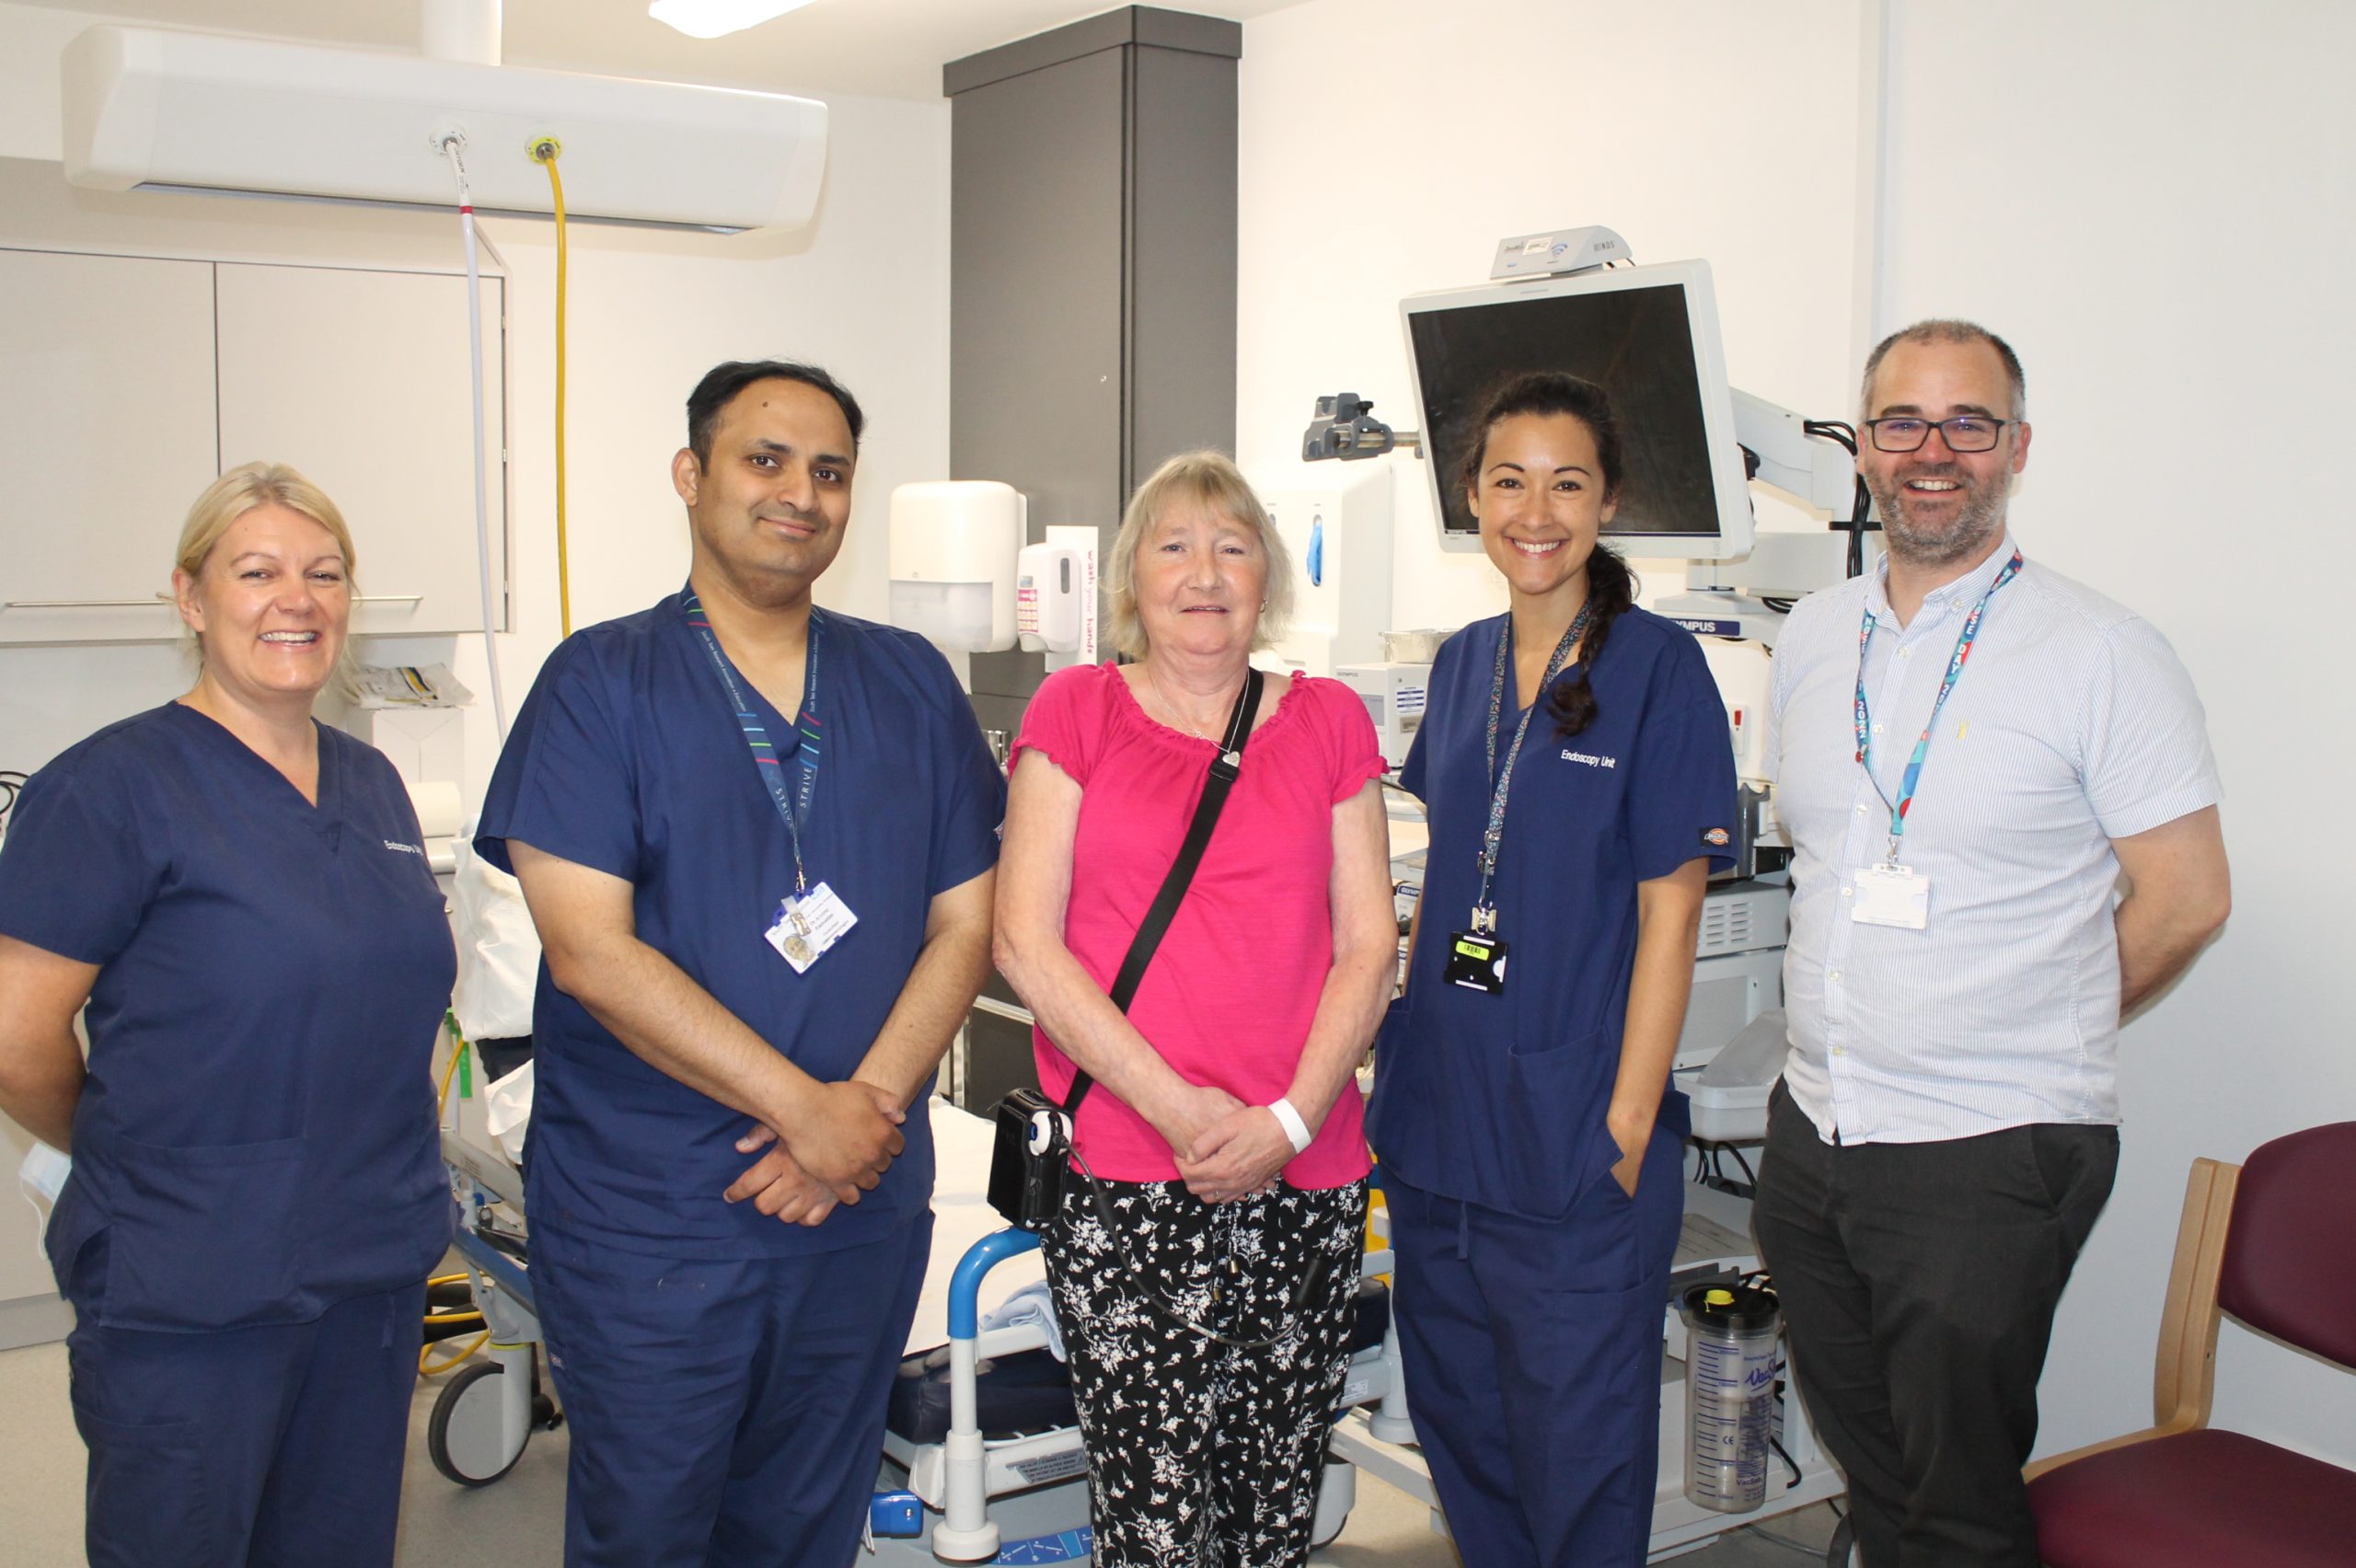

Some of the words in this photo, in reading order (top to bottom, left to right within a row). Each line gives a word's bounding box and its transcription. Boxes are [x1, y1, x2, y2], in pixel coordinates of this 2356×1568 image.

[1086, 618, 1094, 654] hands
[1672, 619, 1715, 633] YMPUS
[1950, 643, 1967, 674] DAY
[1857, 700, 1868, 739] 2022
[1561, 749, 1600, 767] Endoscopy
[1600, 755, 1616, 768] Unit
[800, 767, 813, 809] STRIVE
[775, 788, 792, 826] STRIV
